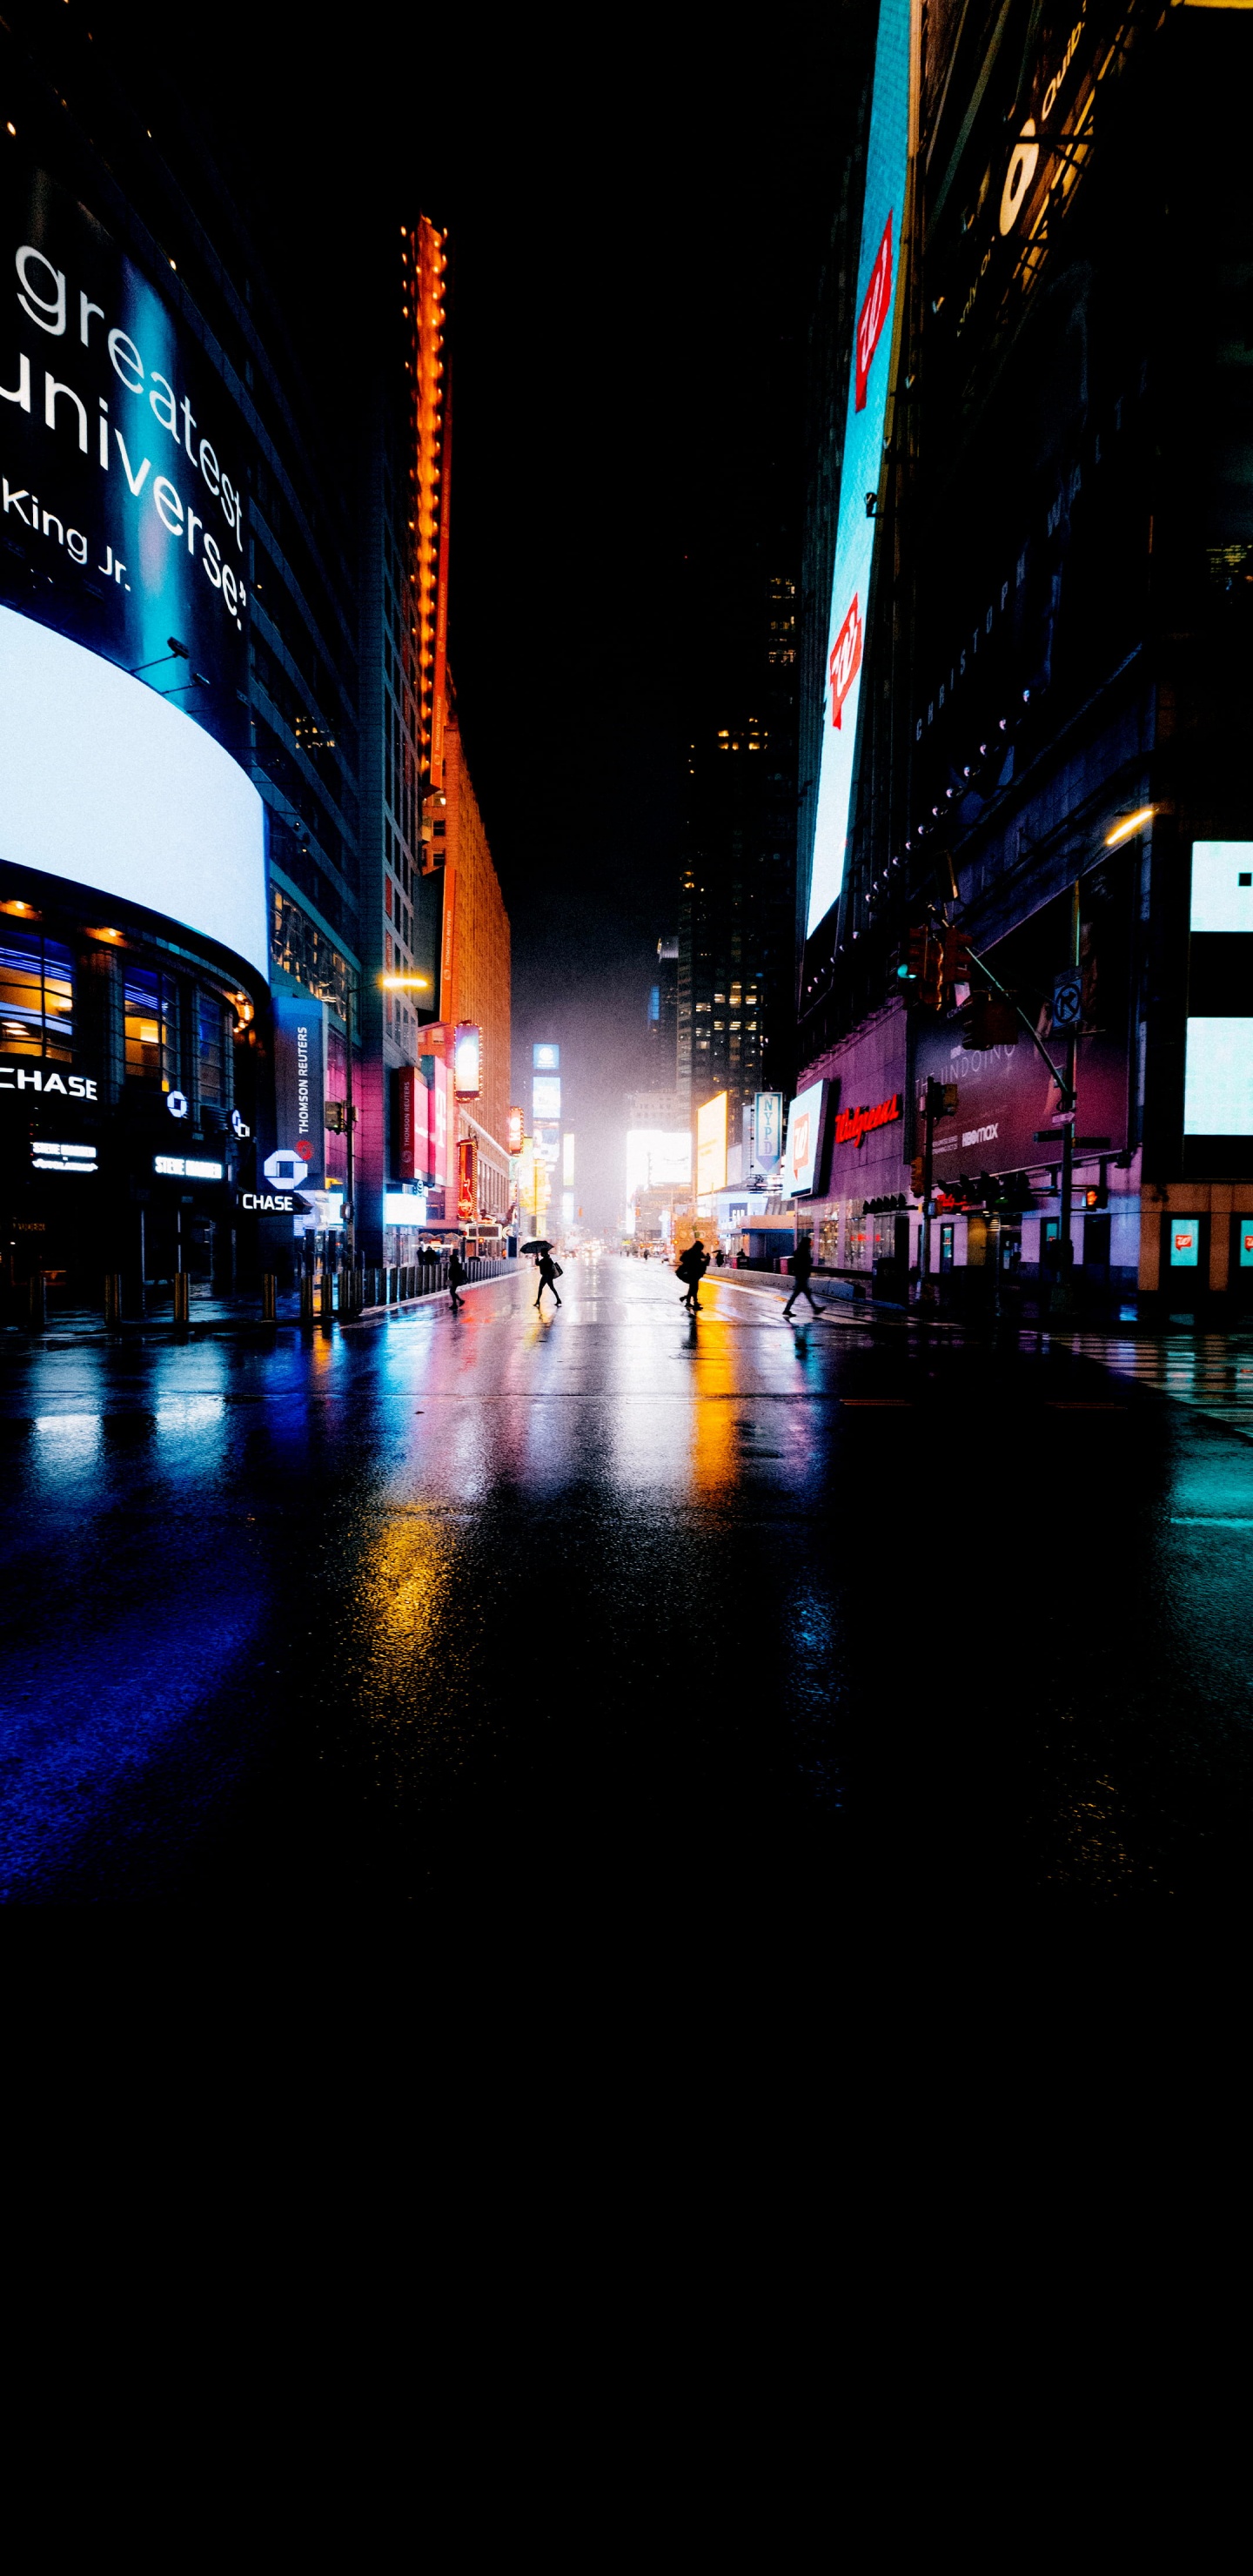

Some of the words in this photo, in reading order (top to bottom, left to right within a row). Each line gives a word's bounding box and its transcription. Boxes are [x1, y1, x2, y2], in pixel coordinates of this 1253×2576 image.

[16, 245, 244, 553] greatest
[3, 474, 88, 565] King
[98, 546, 131, 592] Jr.
[298, 1027, 308, 1077] REUTERS
[298, 1079, 309, 1134] THOMSON
[764, 1097, 774, 1155] NYPD
[835, 1094, 899, 1148] Walgreens
[243, 1194, 293, 1211] CHASE
